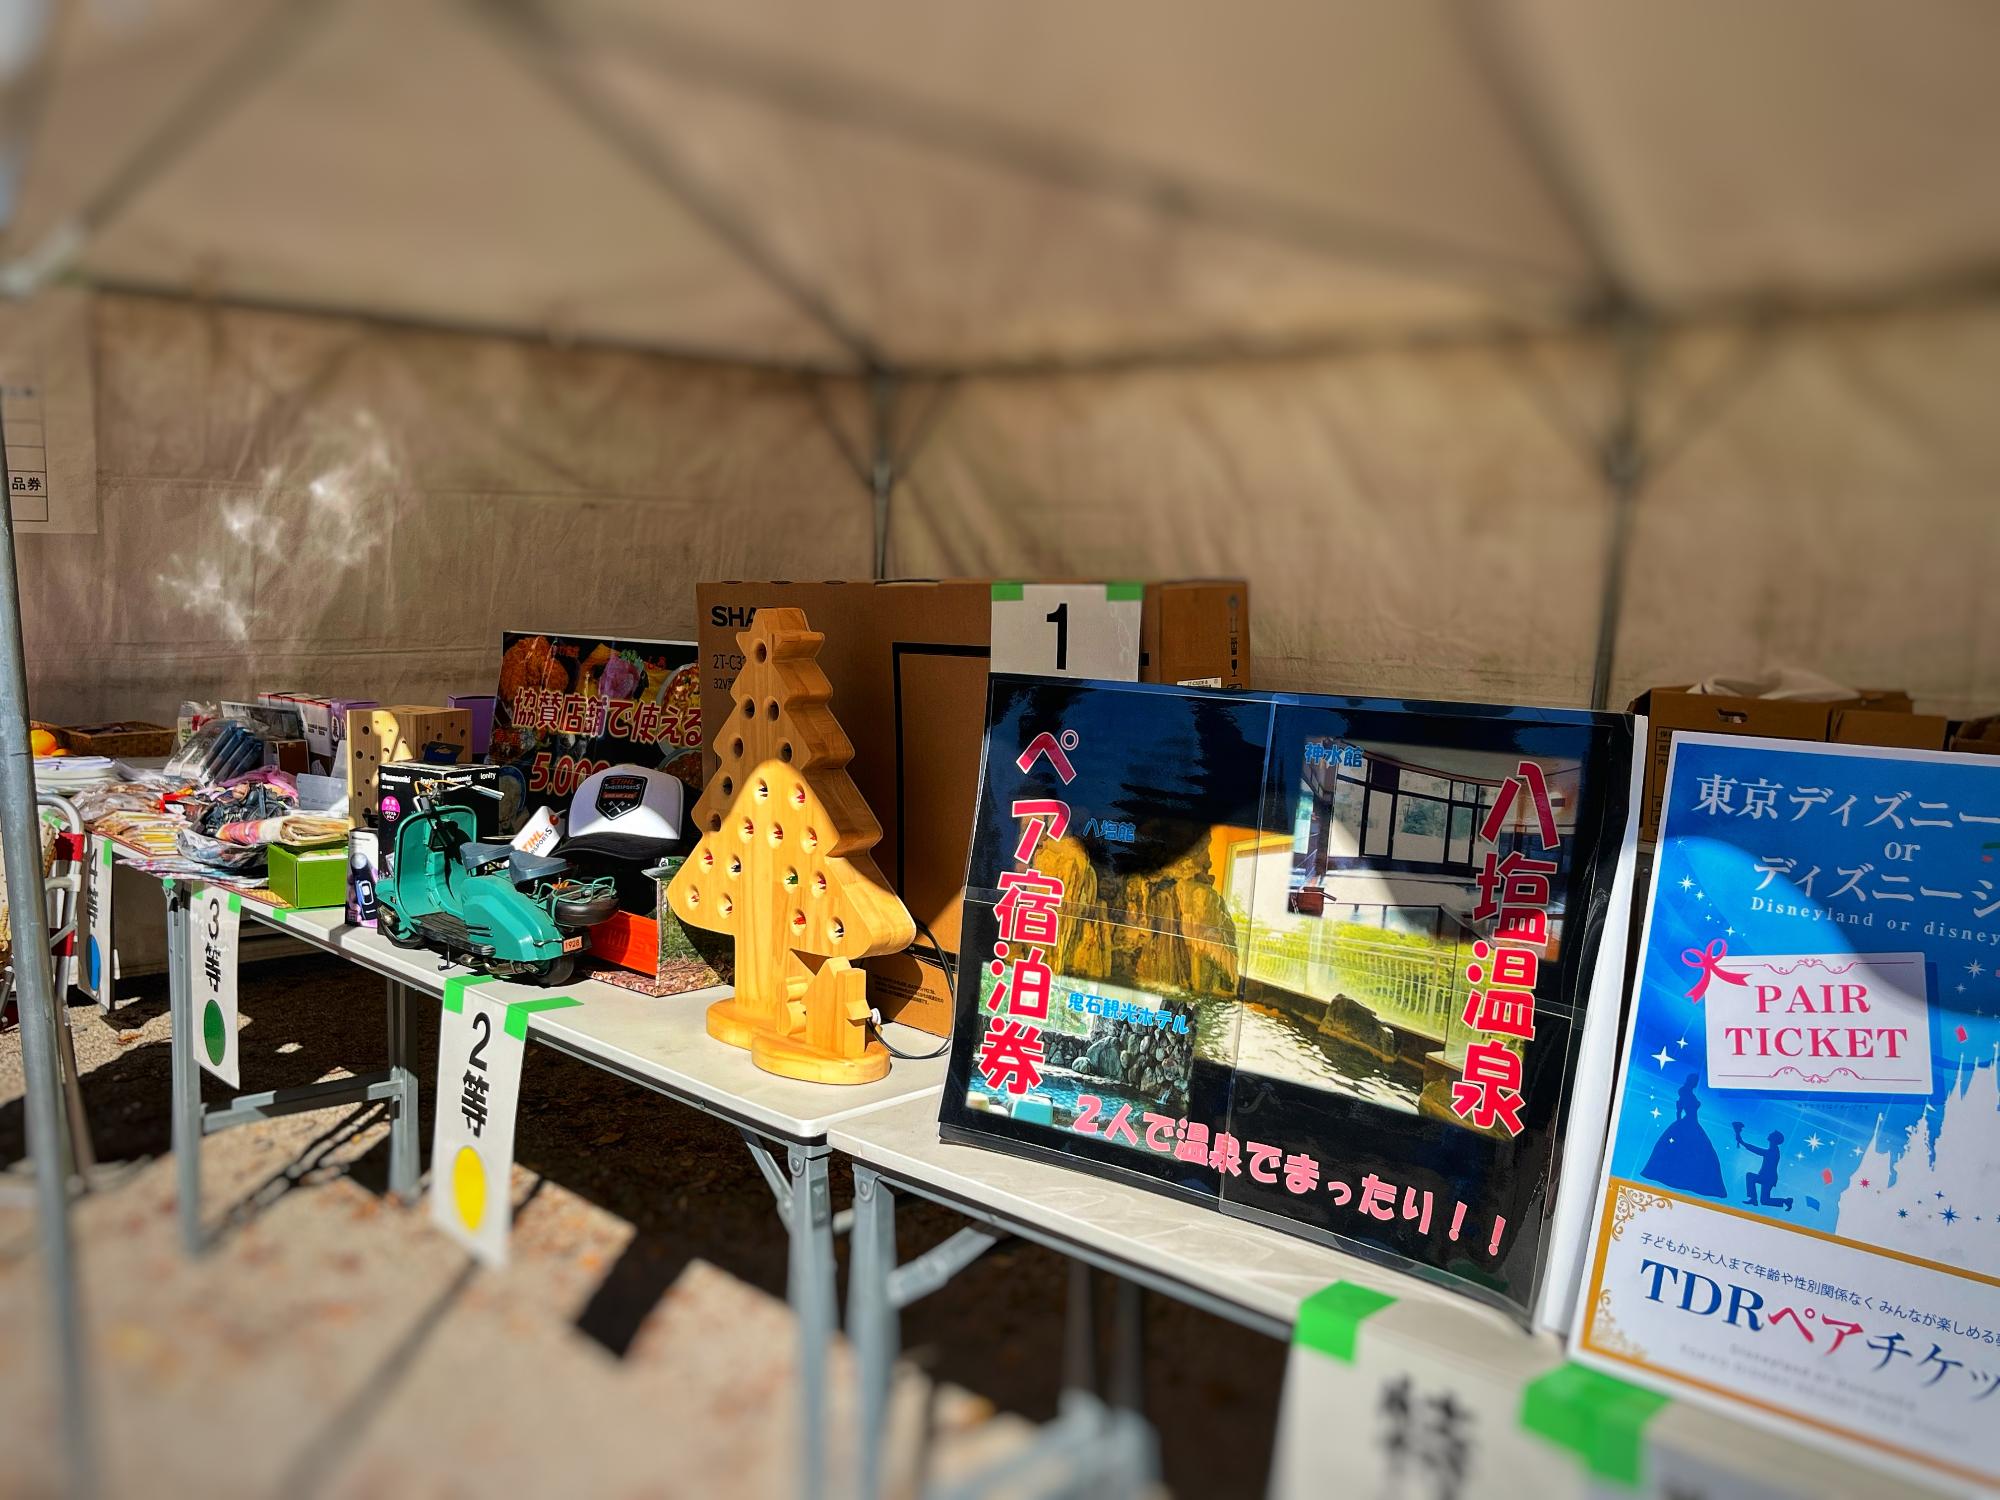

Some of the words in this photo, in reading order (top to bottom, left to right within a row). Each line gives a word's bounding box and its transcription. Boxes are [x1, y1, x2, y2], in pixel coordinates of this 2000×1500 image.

[12, 476, 42, 491] 品券
[711, 605, 758, 628] SHA
[1046, 603, 1068, 670] 1
[713, 654, 746, 671] 2T-C3
[512, 686, 703, 747] 協賛店舗で使える
[1304, 742, 1364, 768] 神水館
[529, 752, 611, 797] 5,00
[1691, 773, 2000, 830] 東京ディズニー
[522, 830, 545, 852] TIHL
[1082, 817, 1136, 843] 八塩館
[1884, 841, 1921, 862] or
[980, 728, 1080, 1096] ペア宿泊券
[1751, 896, 1874, 927] Disneyland
[1887, 918, 1911, 930] or
[1450, 760, 1561, 1138] 八塩温泉
[1067, 991, 1190, 1035] 鬼石観光ホテル
[1754, 984, 1871, 1014] PAIR
[1725, 1027, 1908, 1058] TICKET
[1640, 1232, 1874, 1310] 子どもから大人まで年齢や性別関係なく
[1879, 1300, 2000, 1349] みんなが楽しめる
